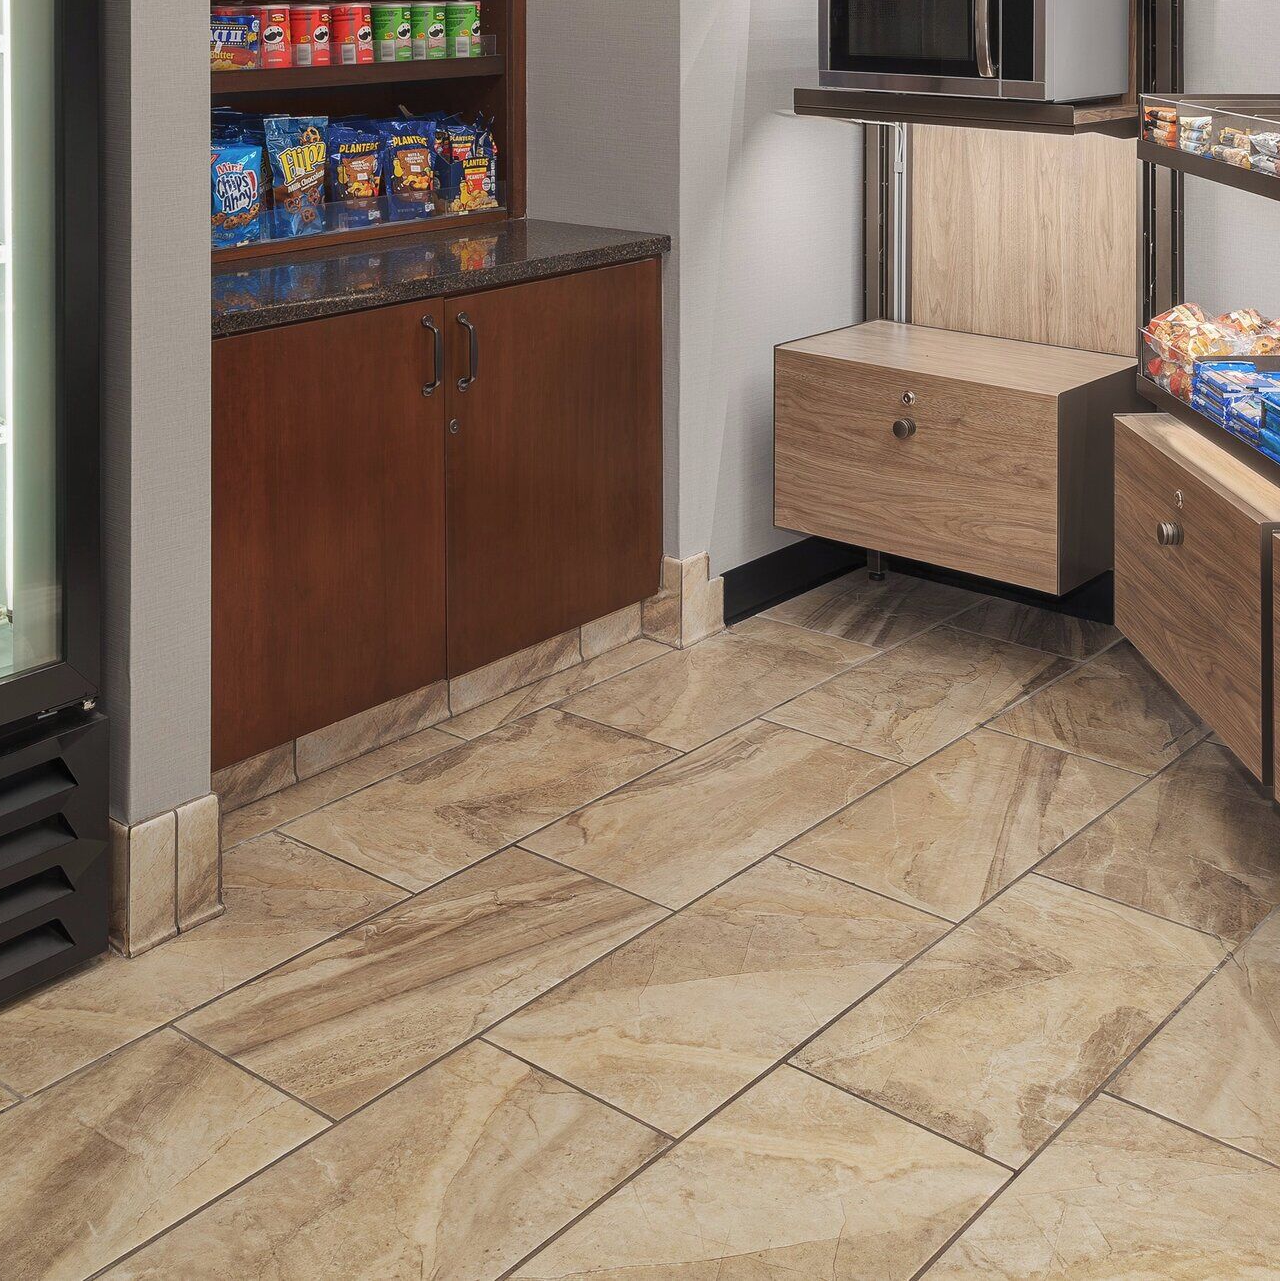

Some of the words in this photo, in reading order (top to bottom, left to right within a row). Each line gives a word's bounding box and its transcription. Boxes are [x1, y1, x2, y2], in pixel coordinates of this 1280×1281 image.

[392, 136, 428, 147] PLANTERS
[340, 142, 378, 154] PLANTERS
[217, 162, 243, 175] Mini
[280, 143, 326, 185] Flipz
[462, 158, 489, 167] PLANTERS
